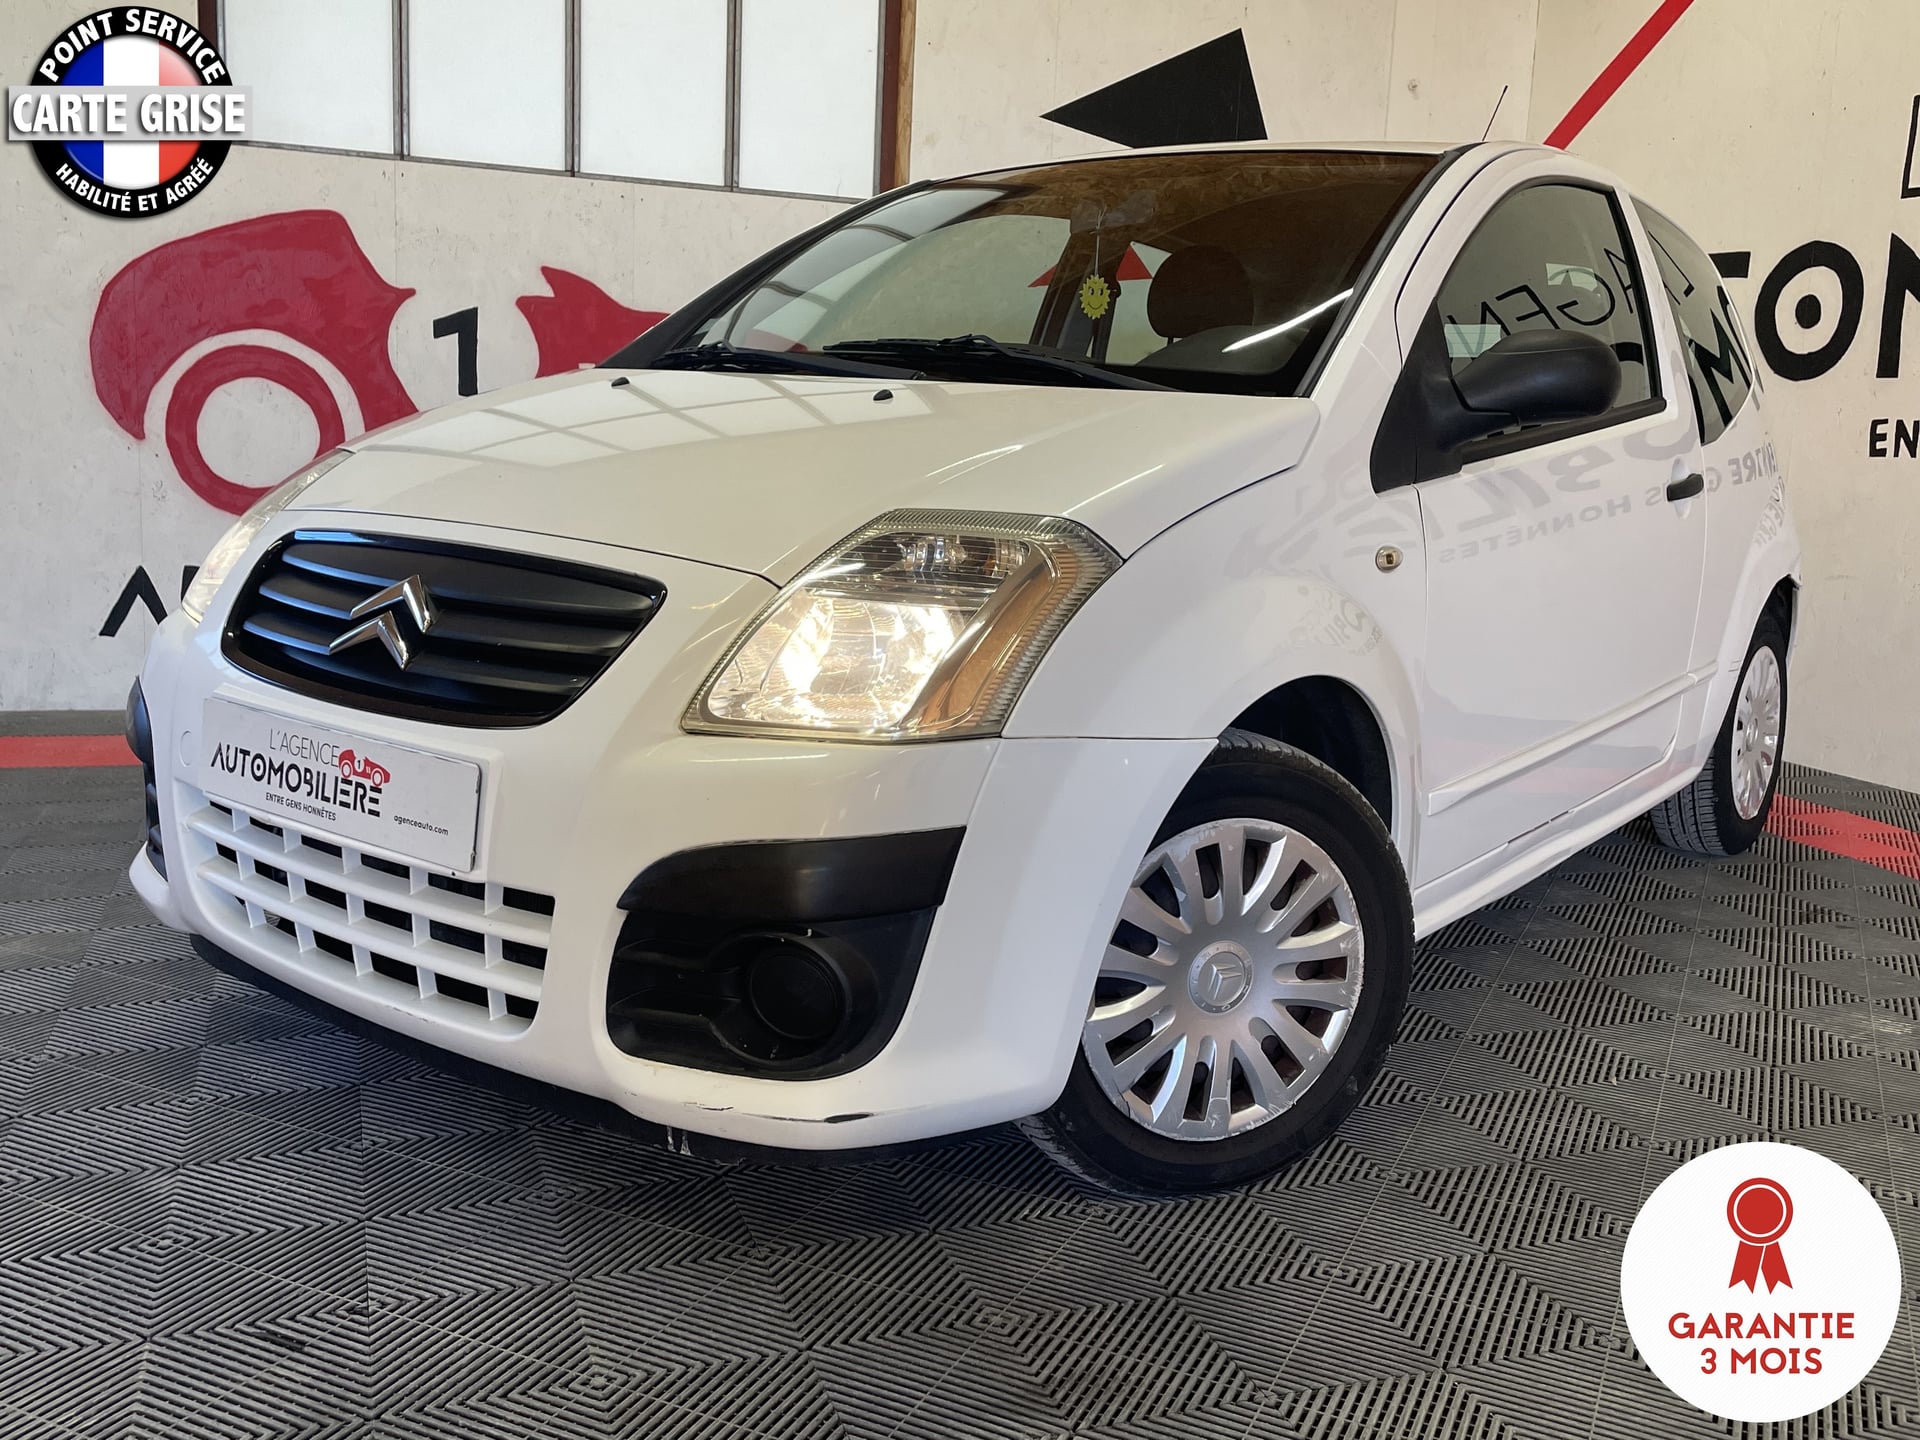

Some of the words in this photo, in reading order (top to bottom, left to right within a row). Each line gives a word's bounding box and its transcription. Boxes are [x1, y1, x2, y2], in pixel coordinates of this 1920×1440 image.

[433, 307, 478, 397] 1
[269, 728, 340, 768] L'AGENCE
[266, 792, 284, 805] ENTRE
[286, 798, 302, 810] GENS
[303, 804, 337, 821] HONNÊTES
[394, 815, 449, 836] agenceauto.com
